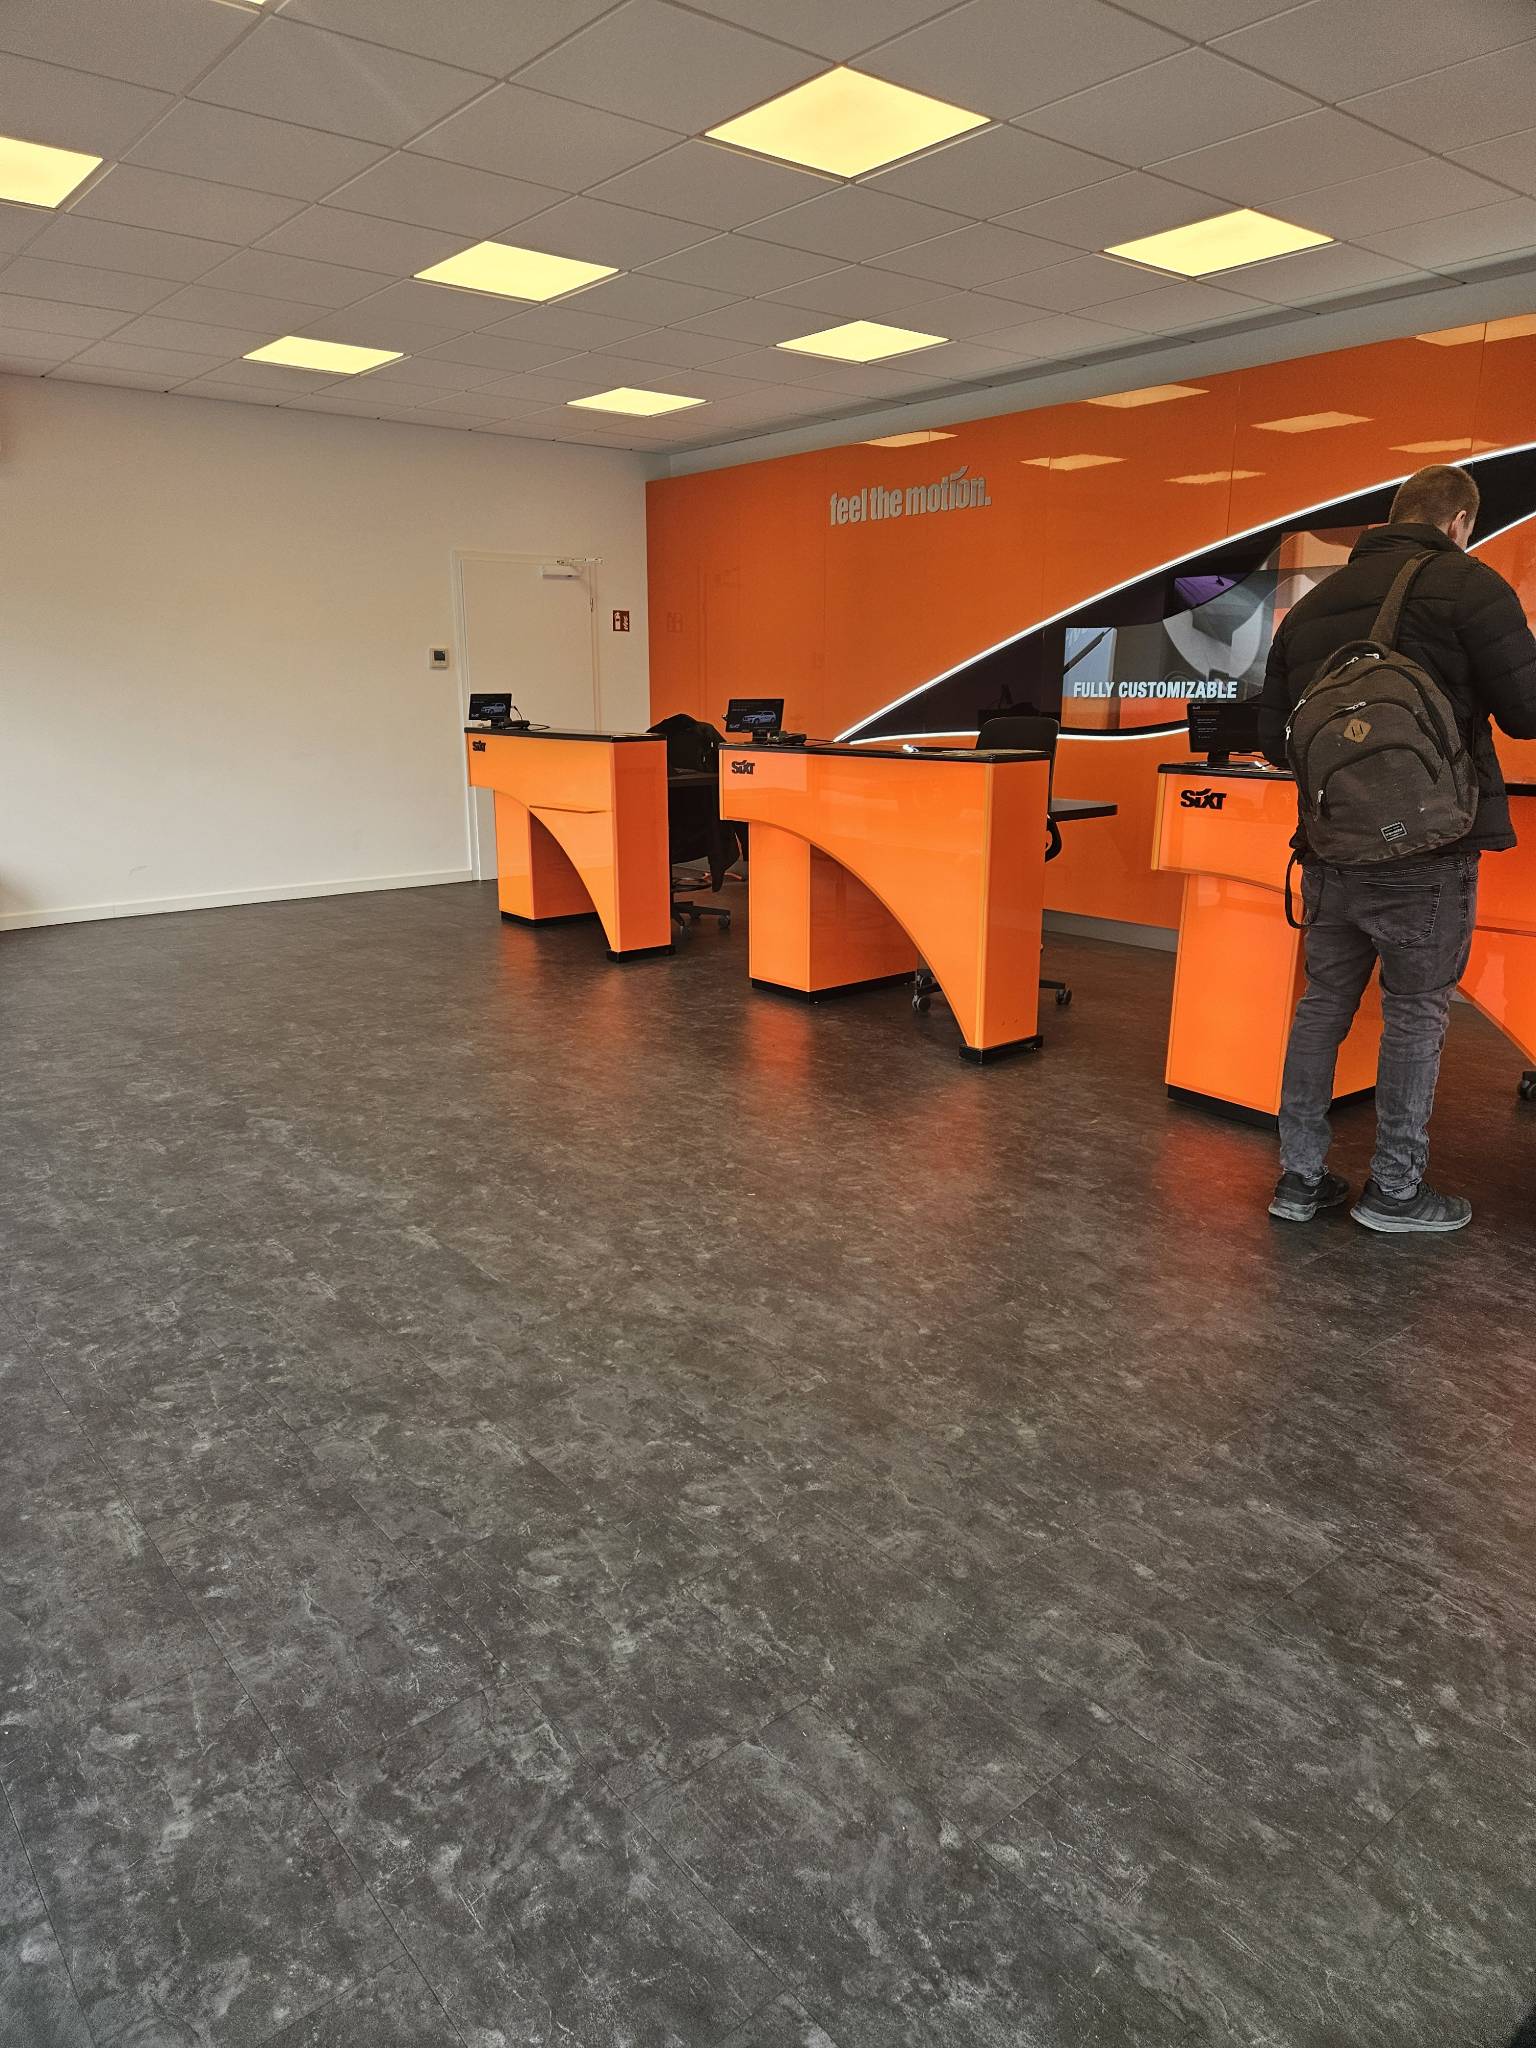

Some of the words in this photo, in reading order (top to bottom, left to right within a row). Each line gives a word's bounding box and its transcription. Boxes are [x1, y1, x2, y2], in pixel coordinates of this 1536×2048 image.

[830, 488, 867, 525] feel
[869, 486, 902, 520] the
[1073, 681, 1114, 698] FULLY
[1118, 681, 1238, 699] CUSTOMIZABLE
